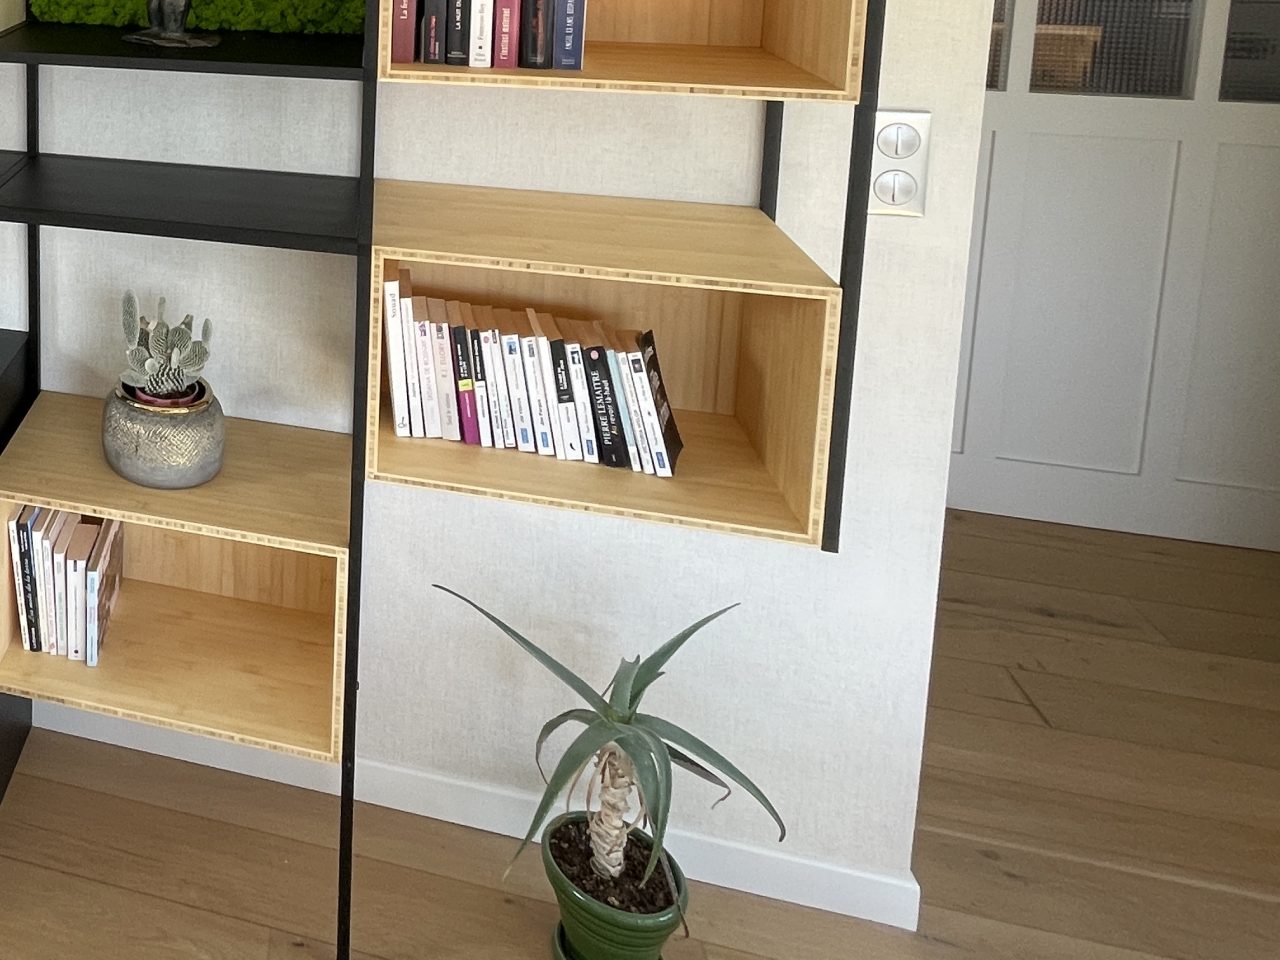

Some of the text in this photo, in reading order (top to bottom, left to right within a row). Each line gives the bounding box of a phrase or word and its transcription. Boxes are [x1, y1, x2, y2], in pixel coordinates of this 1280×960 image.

[401, 10, 408, 19] La
[455, 22, 461, 30] LA
[388, 293, 398, 318] Souad
[591, 370, 612, 445] PIERRE LEMAITRE
[606, 405, 616, 425] revoir
[610, 425, 618, 435] Au
